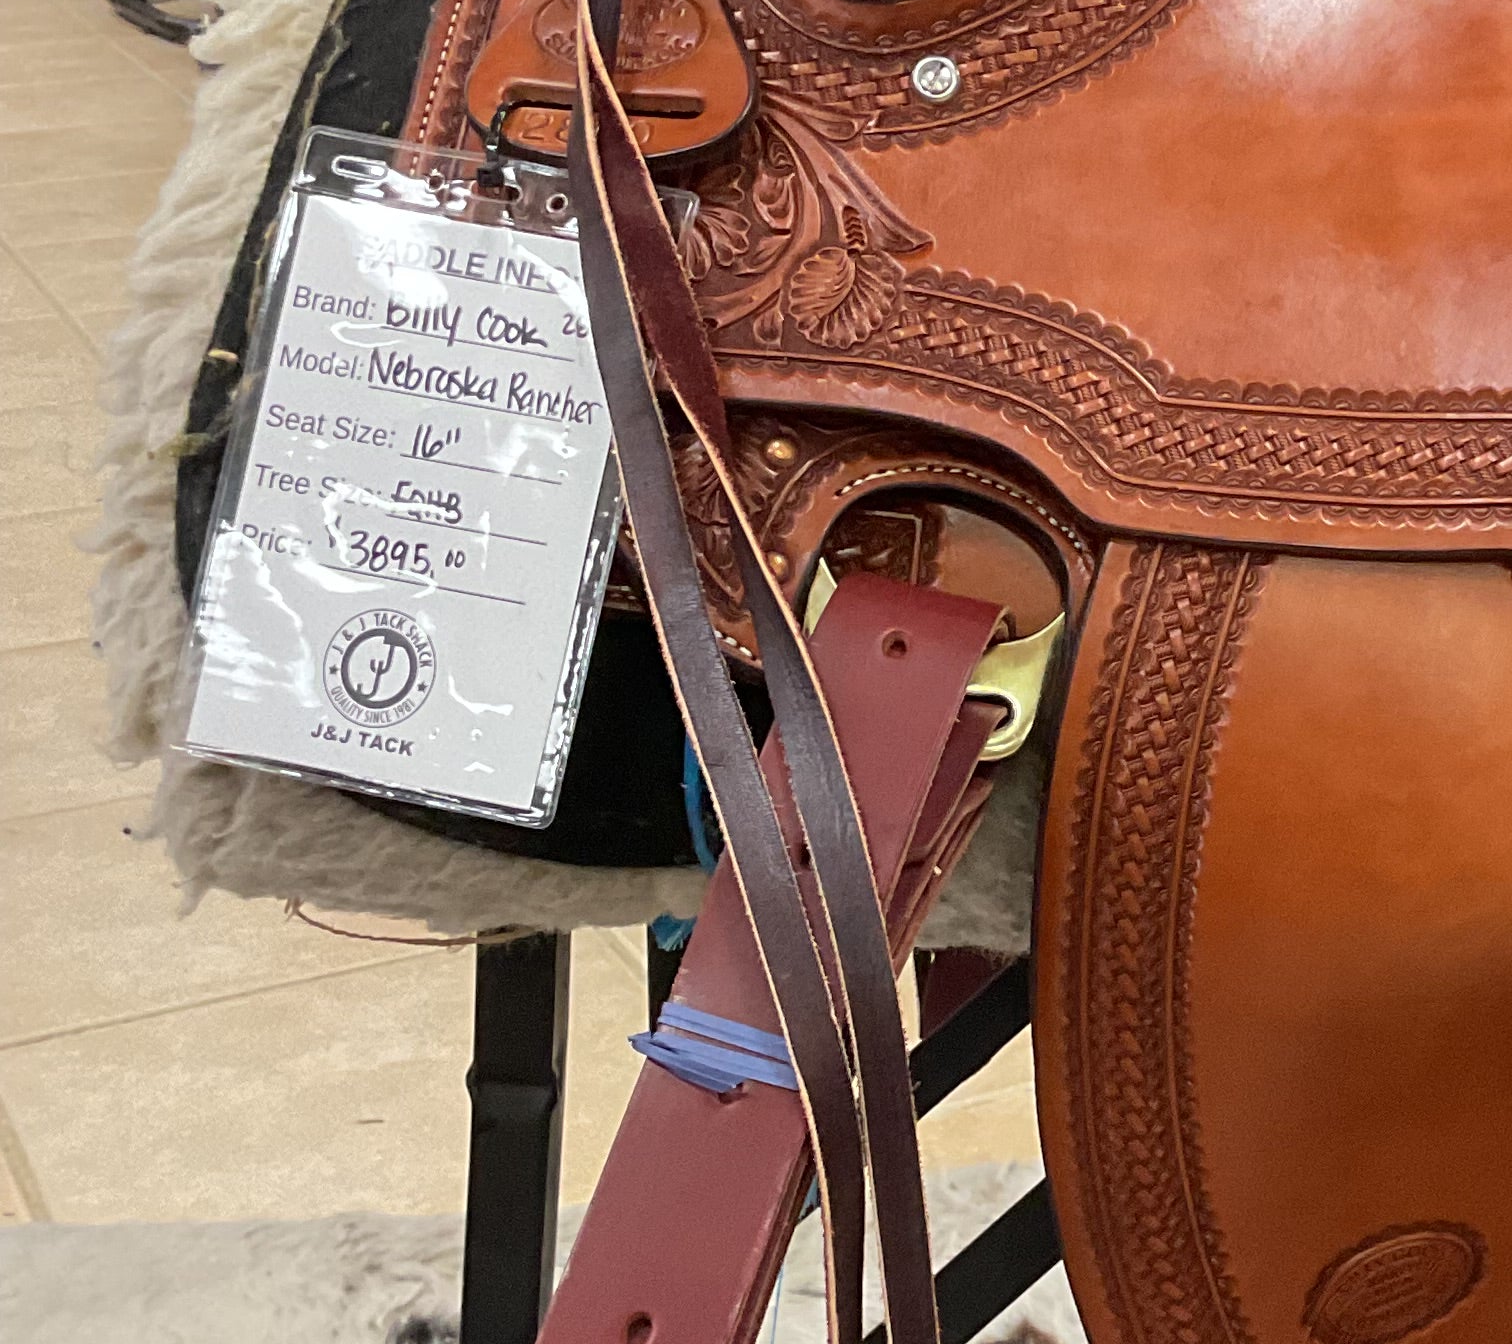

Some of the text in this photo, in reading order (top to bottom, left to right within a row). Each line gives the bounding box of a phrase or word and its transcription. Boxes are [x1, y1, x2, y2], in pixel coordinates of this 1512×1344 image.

[292, 285, 377, 321] Brand:
[386, 294, 462, 347] Billy
[476, 306, 549, 348] Cook
[279, 344, 604, 425] Model: Nebraska Rancher
[266, 403, 327, 431] Seat
[333, 416, 396, 448] Size:
[255, 463, 311, 496] Tree
[359, 617, 367, 631] J
[373, 612, 407, 632] TACK
[405, 624, 433, 668] SHACK
[330, 685, 363, 723] QUALITY
[363, 710, 393, 724] SINCE
[310, 722, 415, 757] J&J TACK
